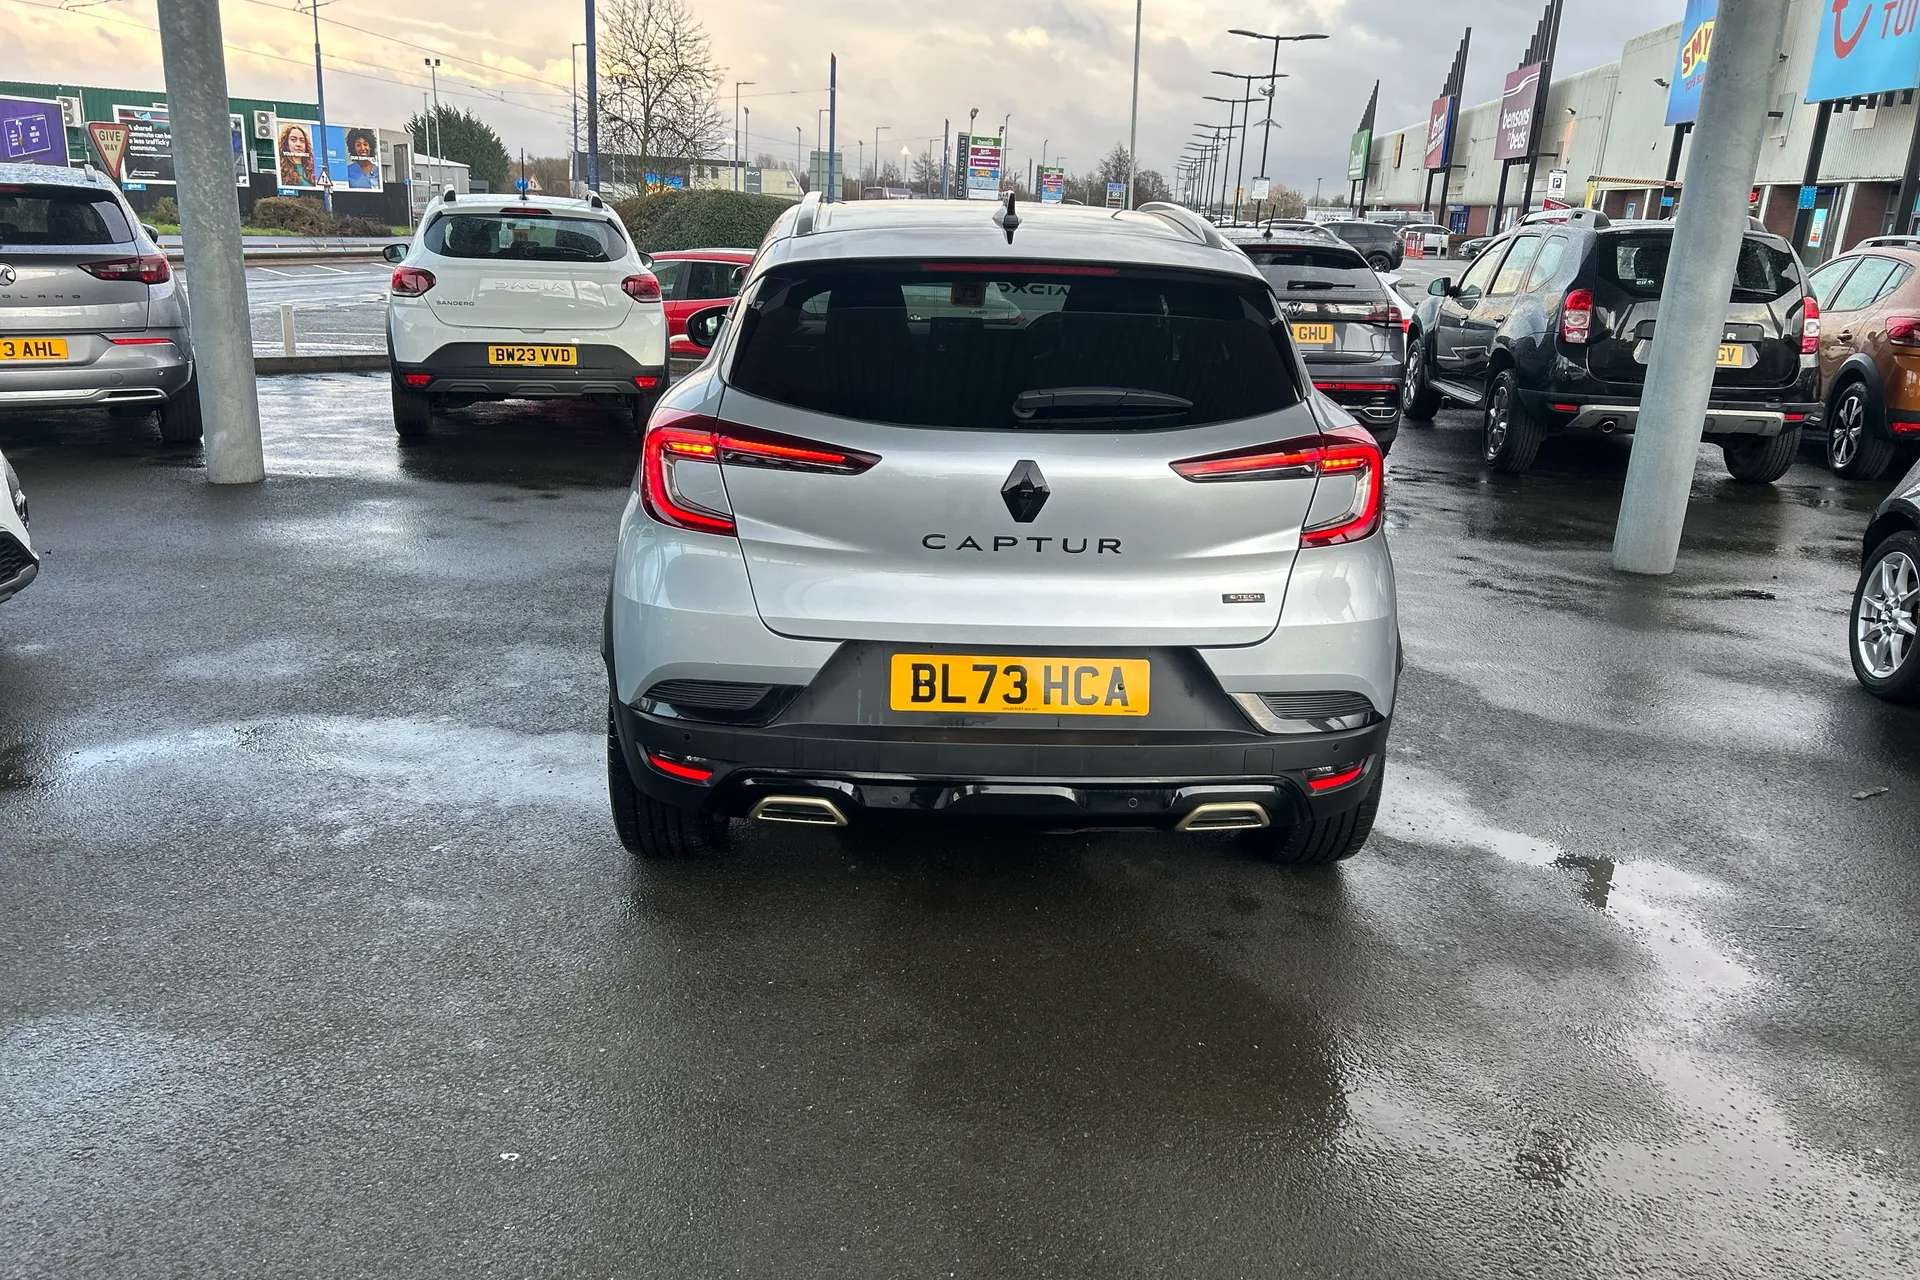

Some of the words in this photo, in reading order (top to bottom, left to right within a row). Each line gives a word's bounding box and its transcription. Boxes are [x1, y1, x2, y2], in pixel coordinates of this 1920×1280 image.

[99, 131, 121, 142] GIVE
[103, 143, 119, 152] WAY
[495, 280, 564, 292] DACIA
[1299, 326, 1328, 340] GHU
[0, 341, 16, 357] 3
[23, 341, 61, 357] AHL
[495, 348, 536, 362] BW23
[541, 348, 571, 363] VVD
[922, 533, 1123, 554] CAPTUR
[910, 662, 1029, 704] BL73
[1043, 664, 1129, 707] HCA
